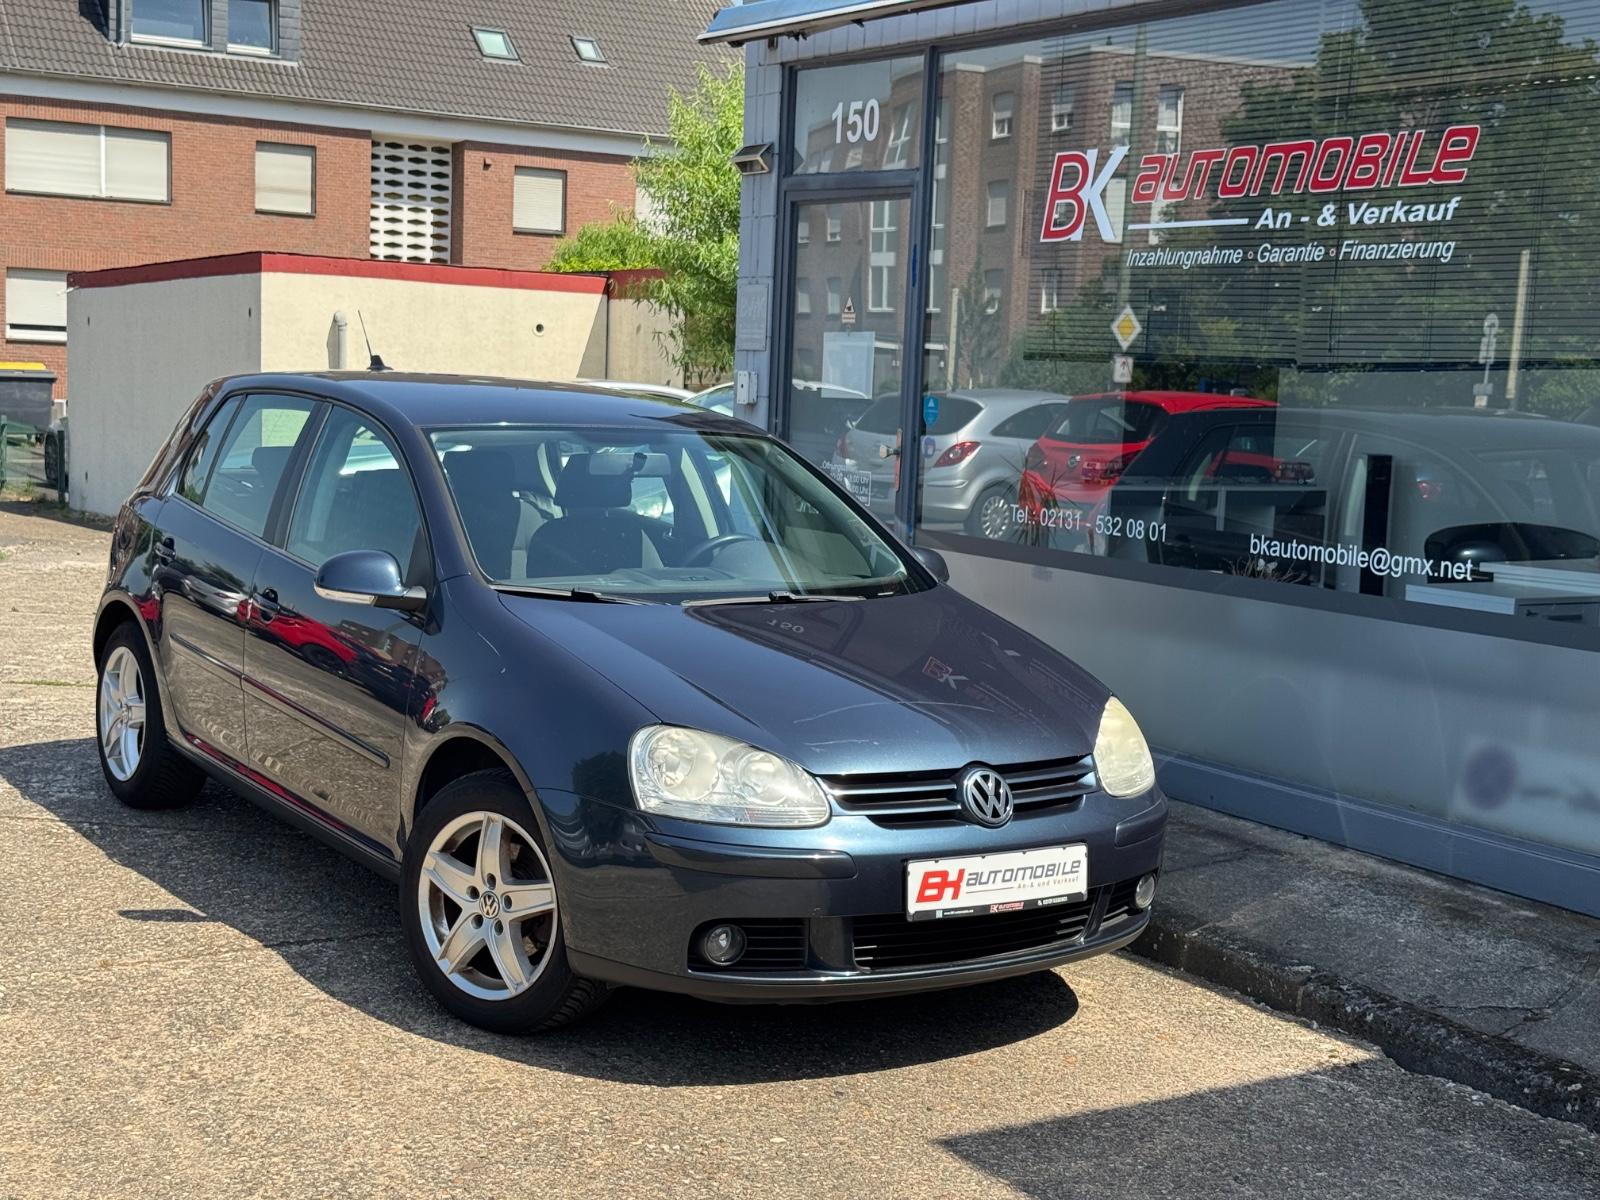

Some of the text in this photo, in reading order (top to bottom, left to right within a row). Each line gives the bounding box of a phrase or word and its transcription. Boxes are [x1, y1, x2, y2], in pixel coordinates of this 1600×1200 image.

[831, 98, 880, 144] 150
[1040, 145, 1131, 243] BK
[1254, 207, 1292, 230] An
[1317, 201, 1337, 227] &
[1348, 196, 1462, 225] Verkauf
[1126, 237, 1456, 270] Inzahlungnahme Garantie Finanzierung
[1010, 503, 1036, 525] Tel.:
[1040, 508, 1081, 531] 02131
[1095, 515, 1122, 537] 532
[1126, 518, 1145, 540] 08
[1149, 521, 1167, 543] 01
[1249, 533, 1474, 582] bkautomobile@gmx.net
